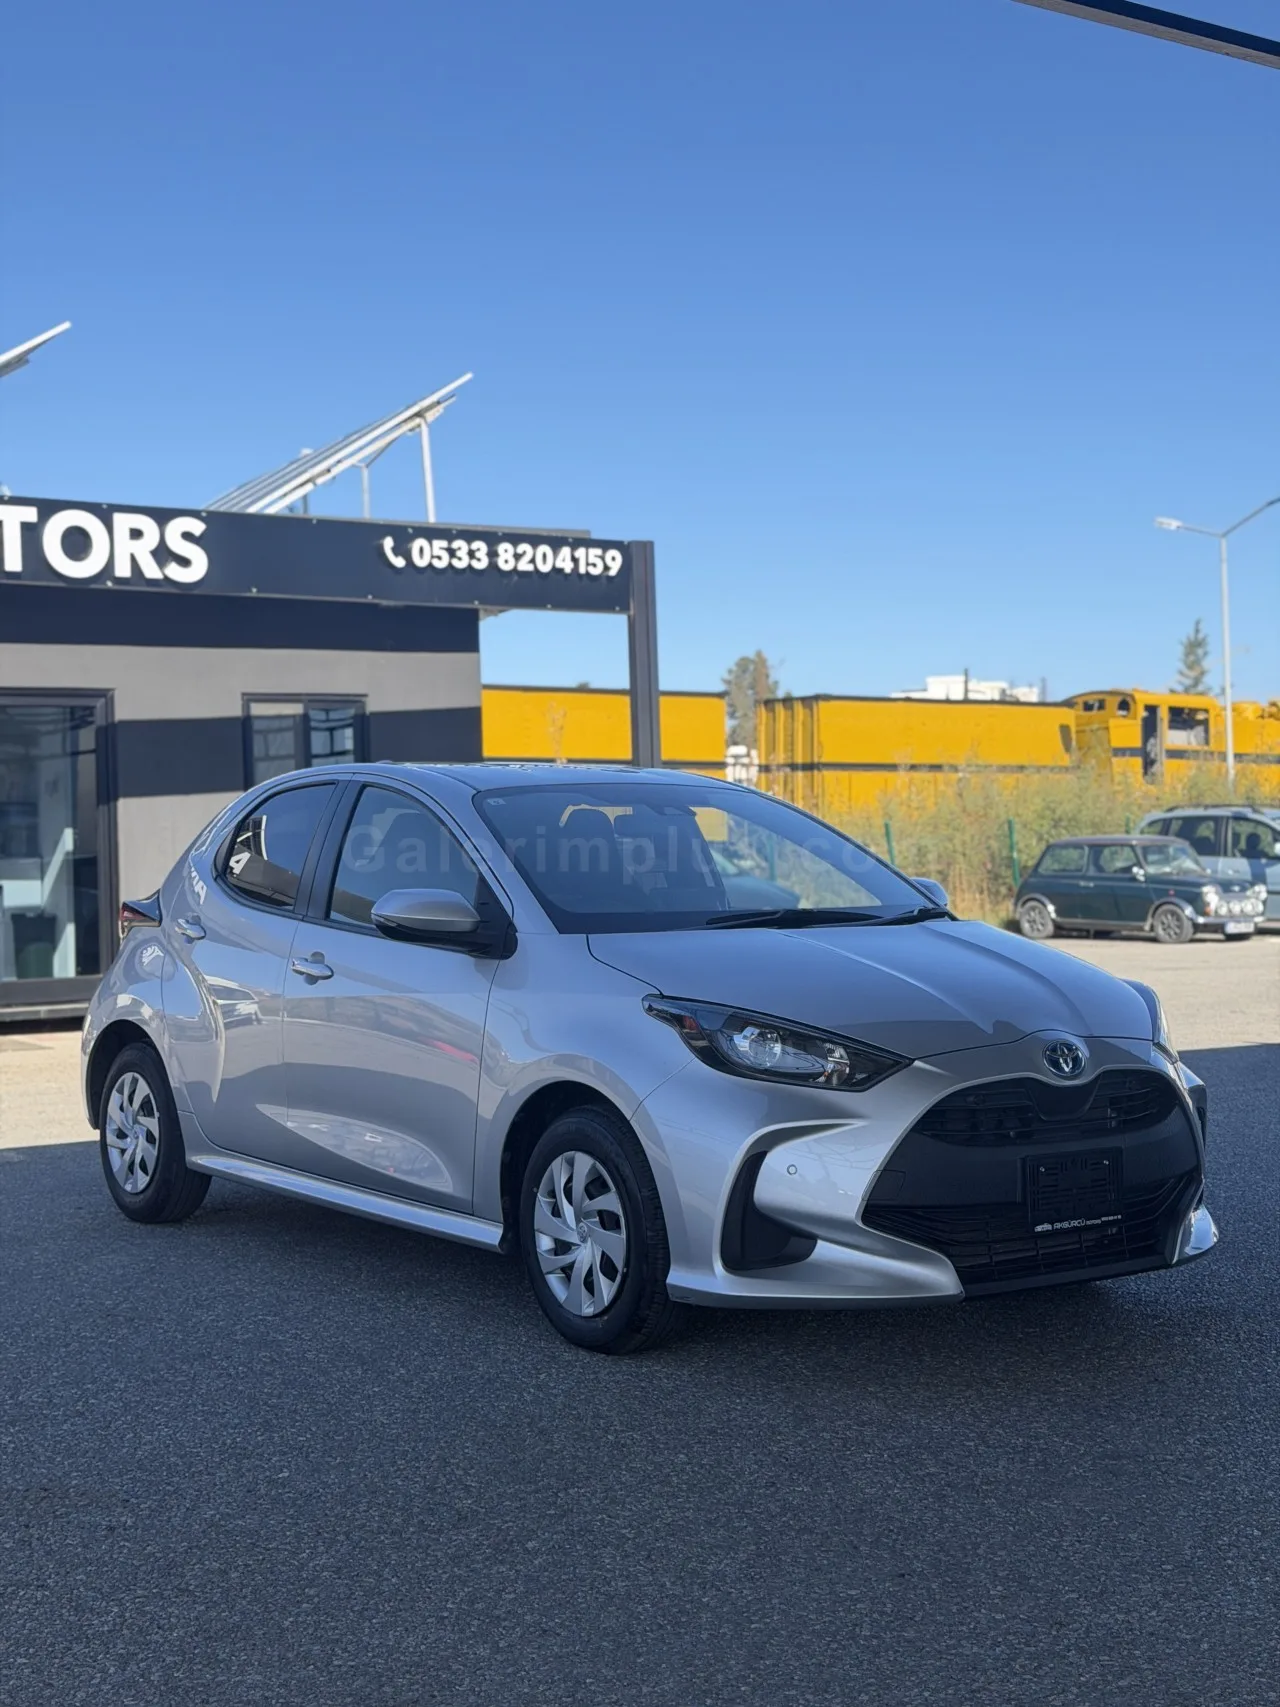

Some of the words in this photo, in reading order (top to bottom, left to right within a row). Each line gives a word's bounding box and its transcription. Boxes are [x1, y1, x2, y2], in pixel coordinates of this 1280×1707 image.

[0, 504, 209, 583] TORS
[411, 537, 490, 570] 0533
[497, 541, 623, 577] 8204159
